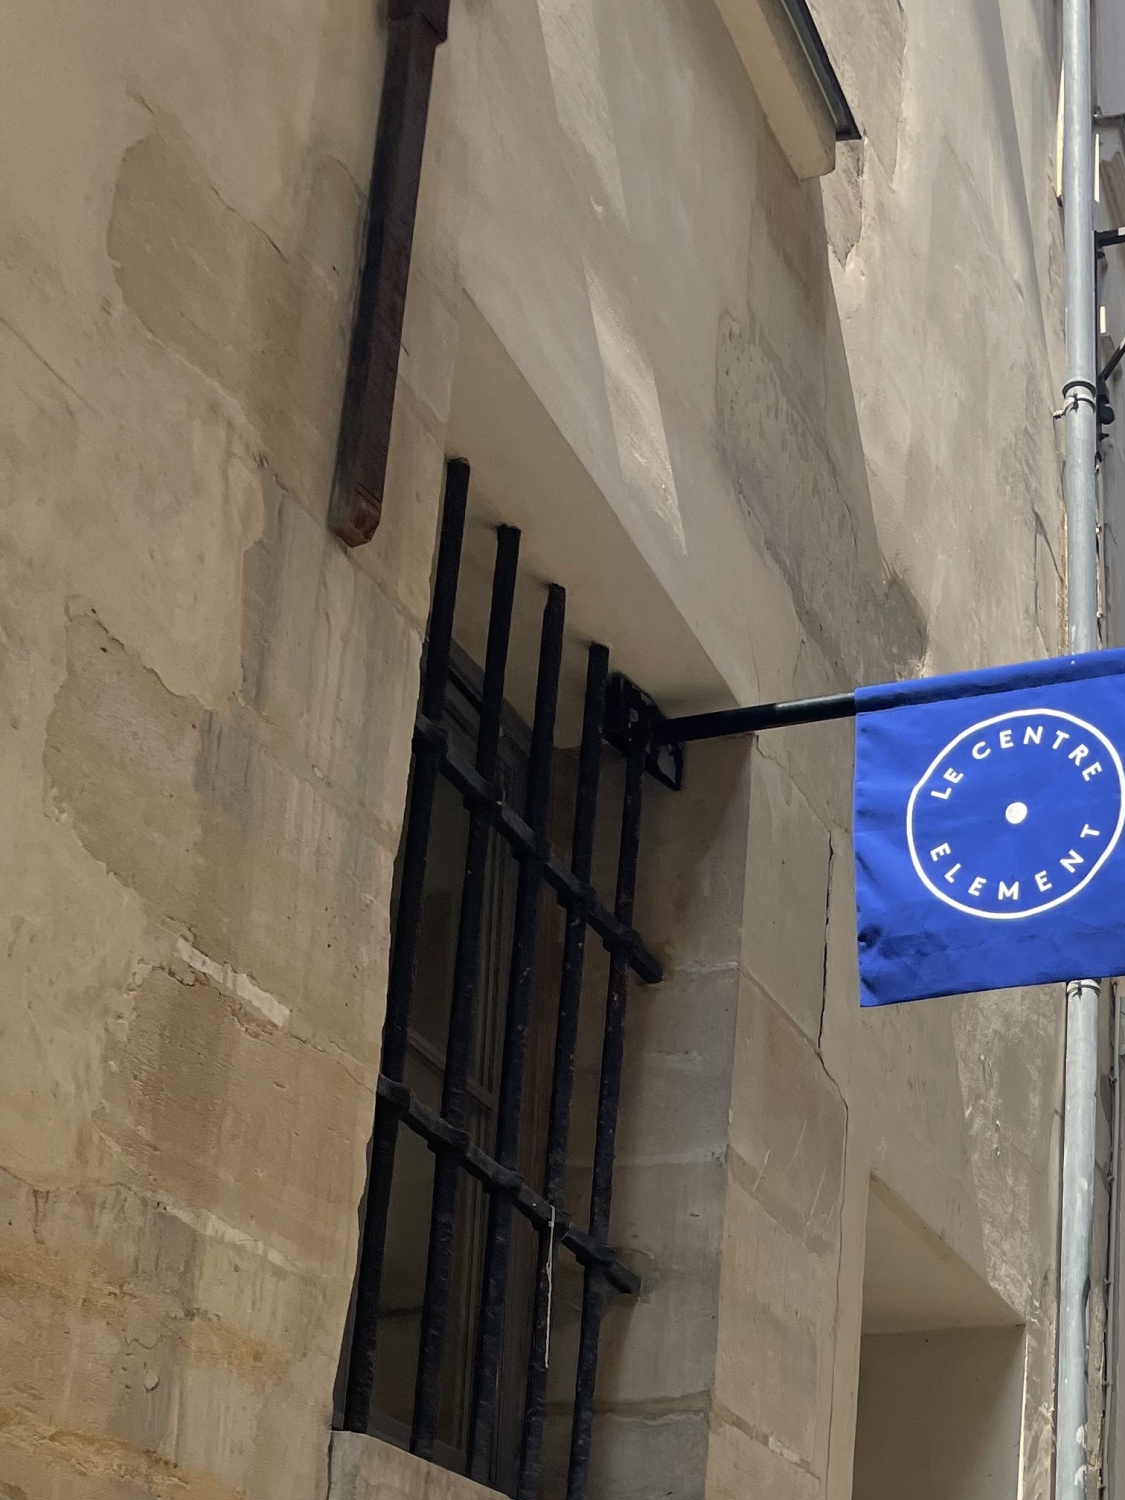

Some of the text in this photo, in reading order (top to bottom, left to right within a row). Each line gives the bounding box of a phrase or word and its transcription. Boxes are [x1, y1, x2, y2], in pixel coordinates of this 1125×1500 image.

[930, 725, 1103, 800] LE CENTRE
[930, 823, 1100, 901] ELEMENT
